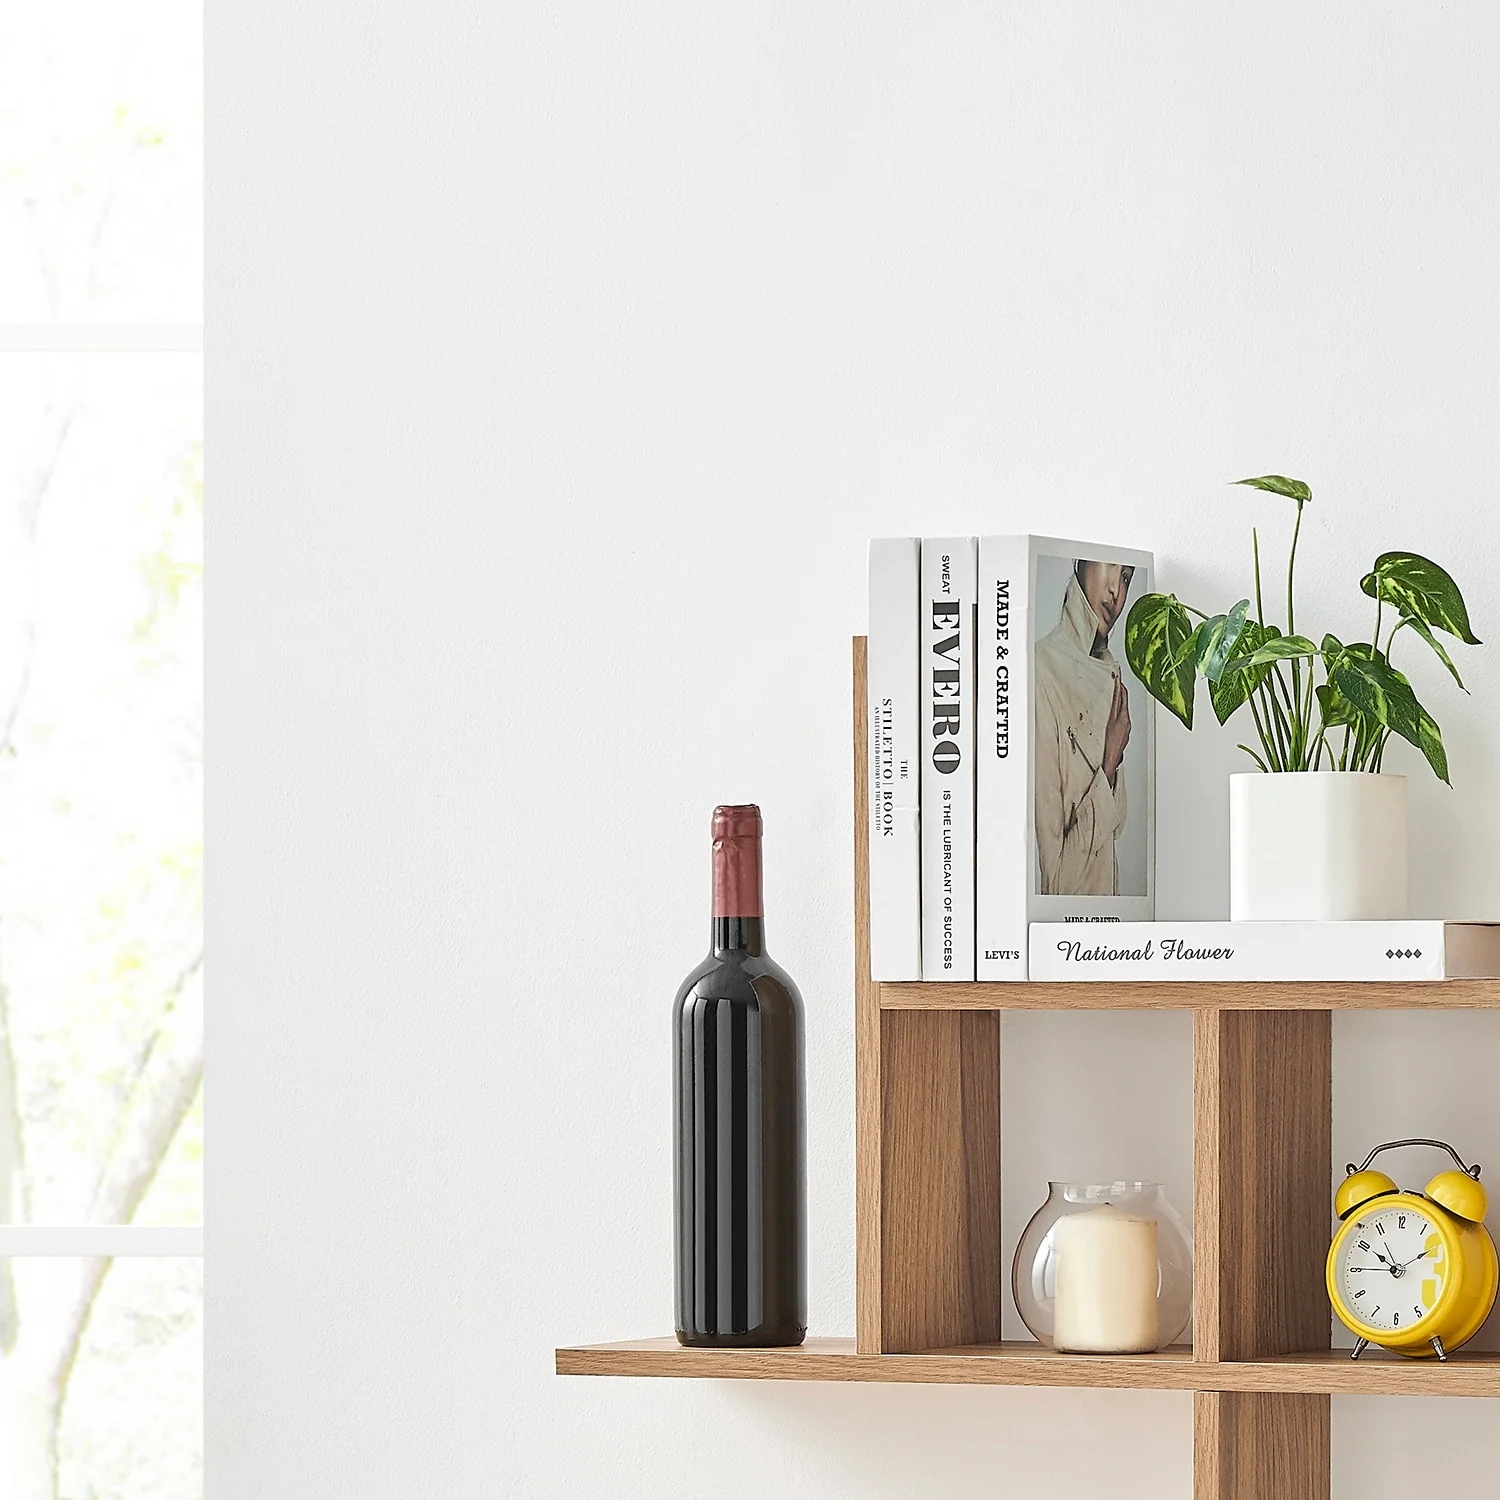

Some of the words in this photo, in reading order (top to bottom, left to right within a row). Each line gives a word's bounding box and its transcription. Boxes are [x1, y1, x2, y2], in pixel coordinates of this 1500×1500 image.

[941, 555, 951, 595] SWEAT
[996, 580, 1010, 641] MADE
[996, 645, 1010, 661] &
[931, 598, 962, 775] EVERO
[996, 665, 1010, 759] CRAFTED
[900, 759, 908, 780] THE
[942, 790, 952, 800] IS
[883, 791, 894, 837] BOOK
[943, 803, 952, 827] THE
[943, 829, 952, 894] LUBRICANT
[943, 897, 953, 913] OF
[943, 915, 953, 970] SUCCESS
[1056, 939, 1156, 962] National
[1160, 938, 1236, 962] Flower
[984, 949, 1021, 961] LEVI'S
[1375, 1222, 1386, 1236] 11
[1398, 1215, 1406, 1229] 12
[1357, 1239, 1371, 1252] 10
[1354, 1289, 1366, 1299] 8
[1370, 1305, 1381, 1318] 7
[1393, 1312, 1399, 1326] 6
[1413, 1305, 1423, 1319] 5
